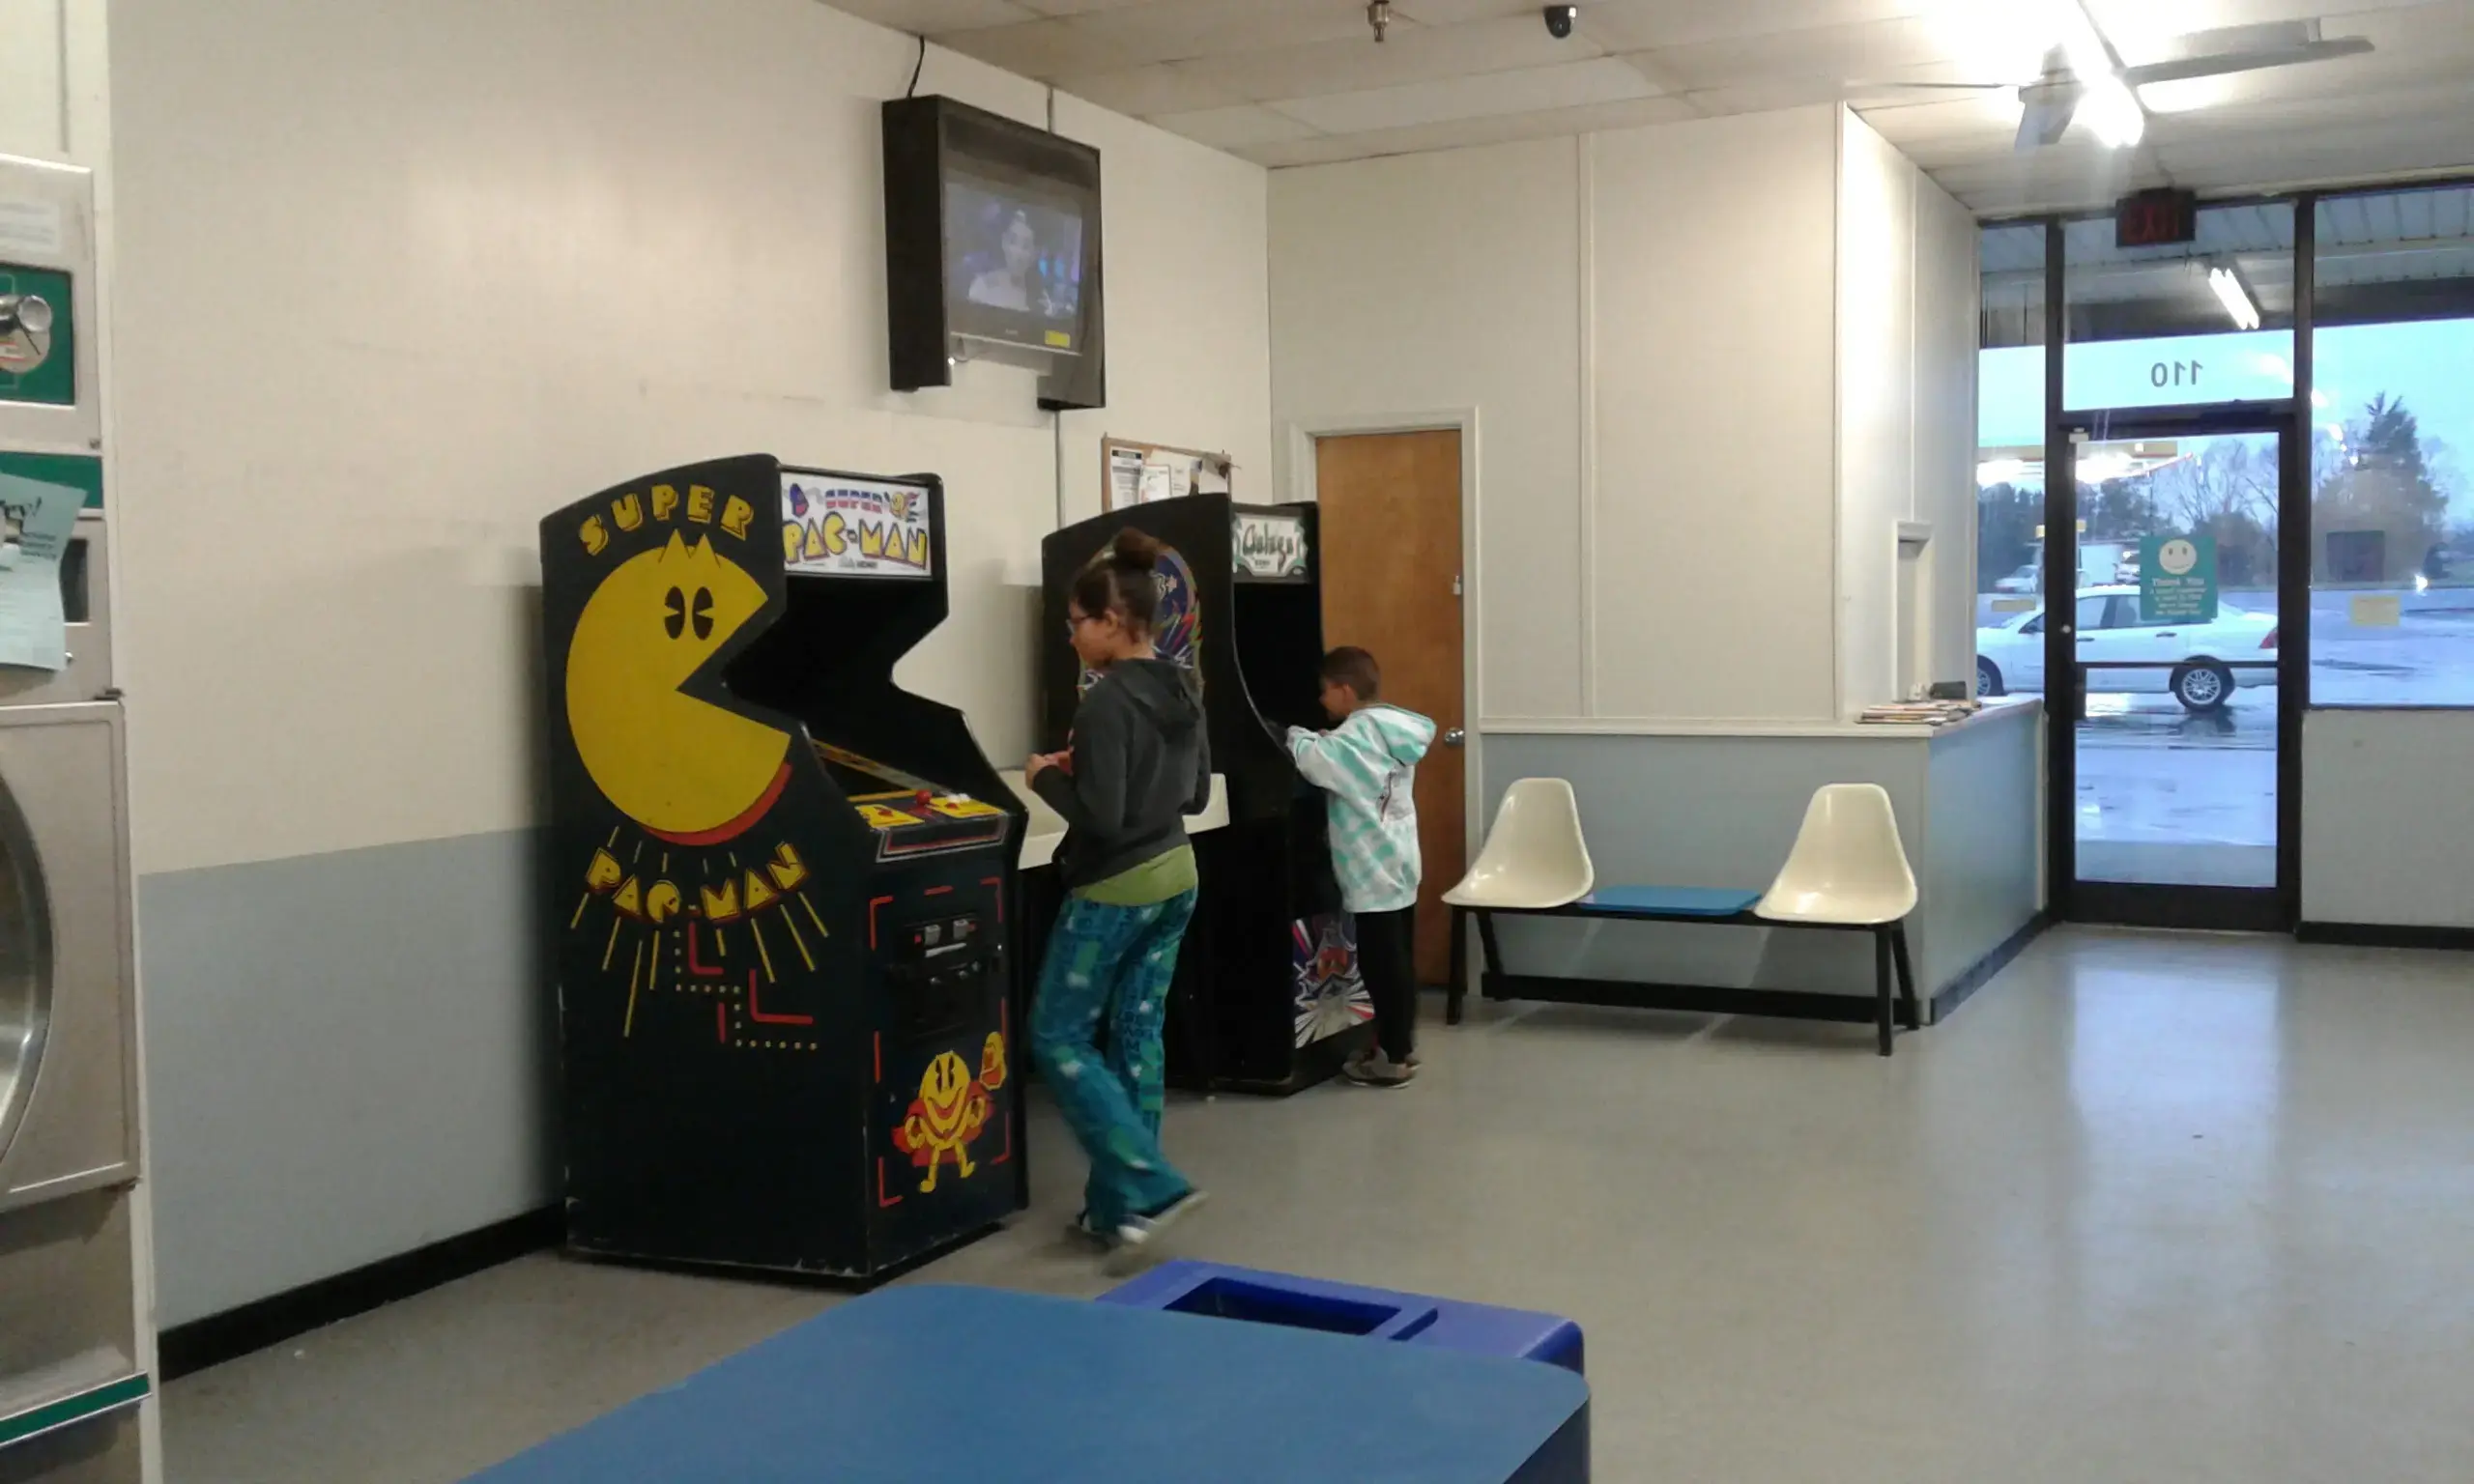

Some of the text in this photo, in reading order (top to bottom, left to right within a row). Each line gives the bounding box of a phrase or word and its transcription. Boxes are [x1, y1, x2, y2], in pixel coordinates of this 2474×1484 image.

[579, 484, 754, 556] SUPER
[825, 489, 882, 514] SUPER
[783, 511, 928, 570] PAC-MAN
